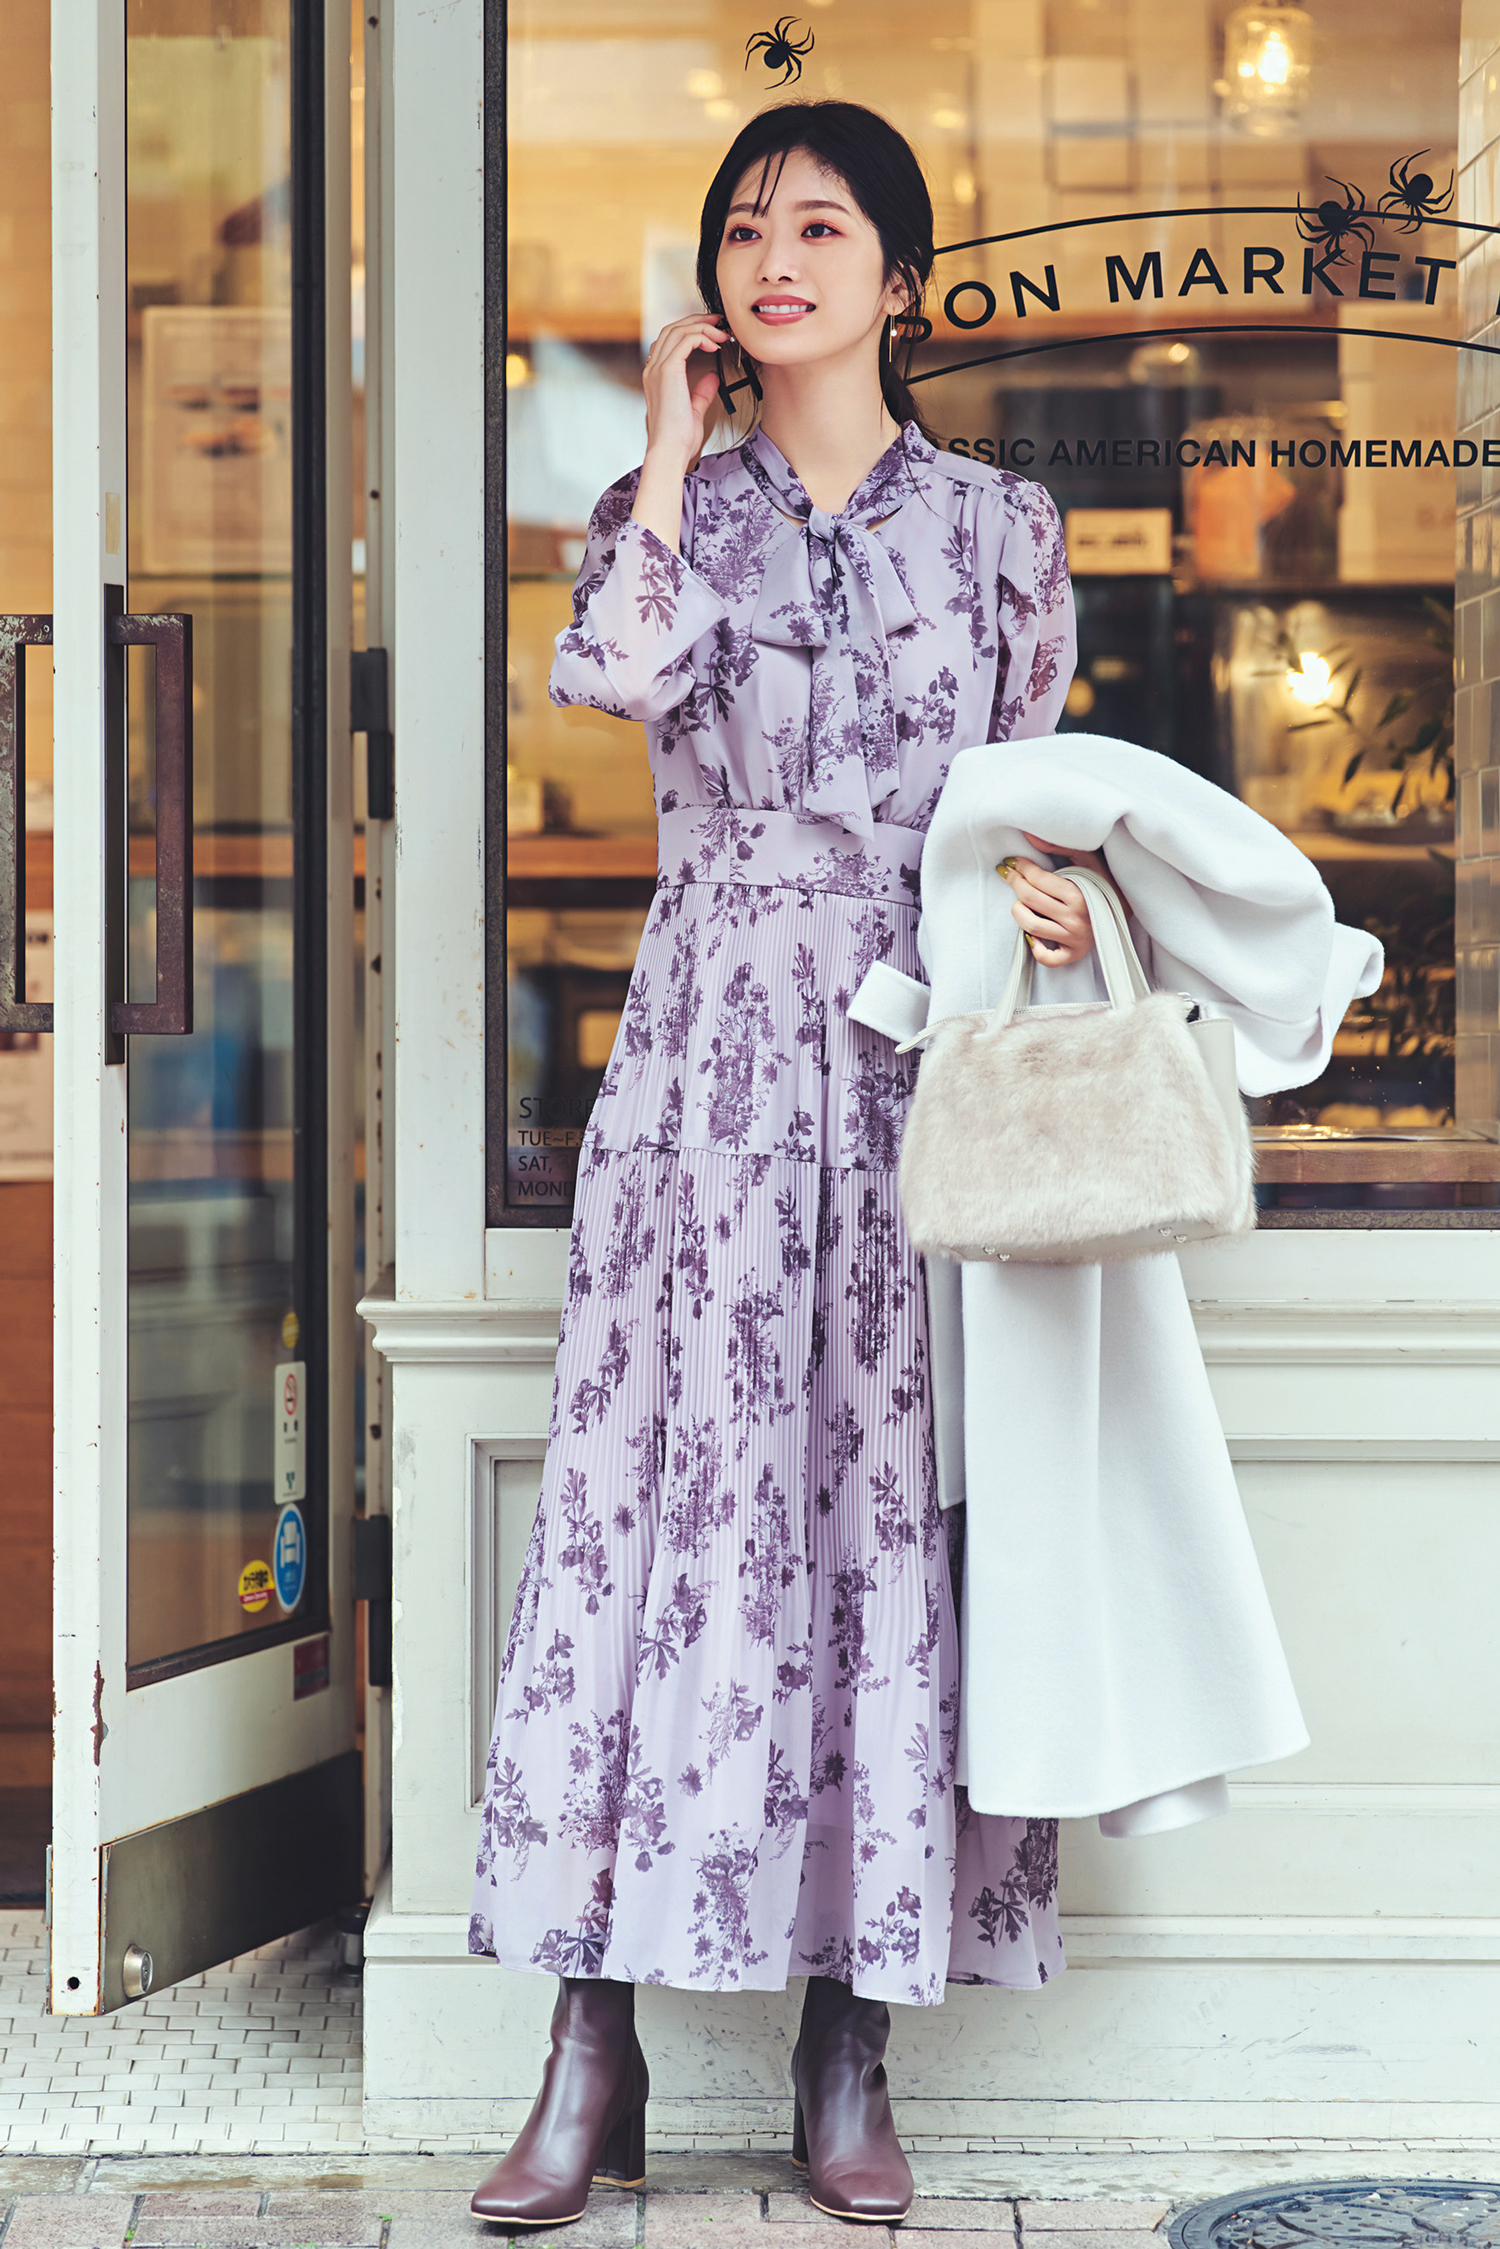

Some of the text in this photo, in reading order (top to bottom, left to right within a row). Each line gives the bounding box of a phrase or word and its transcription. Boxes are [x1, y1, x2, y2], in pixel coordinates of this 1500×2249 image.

[1105, 246, 1457, 305] MARKET
[947, 437, 1500, 467] SSIC AMERICAN HOMEMADE
[517, 1155, 552, 1173] SAT,
